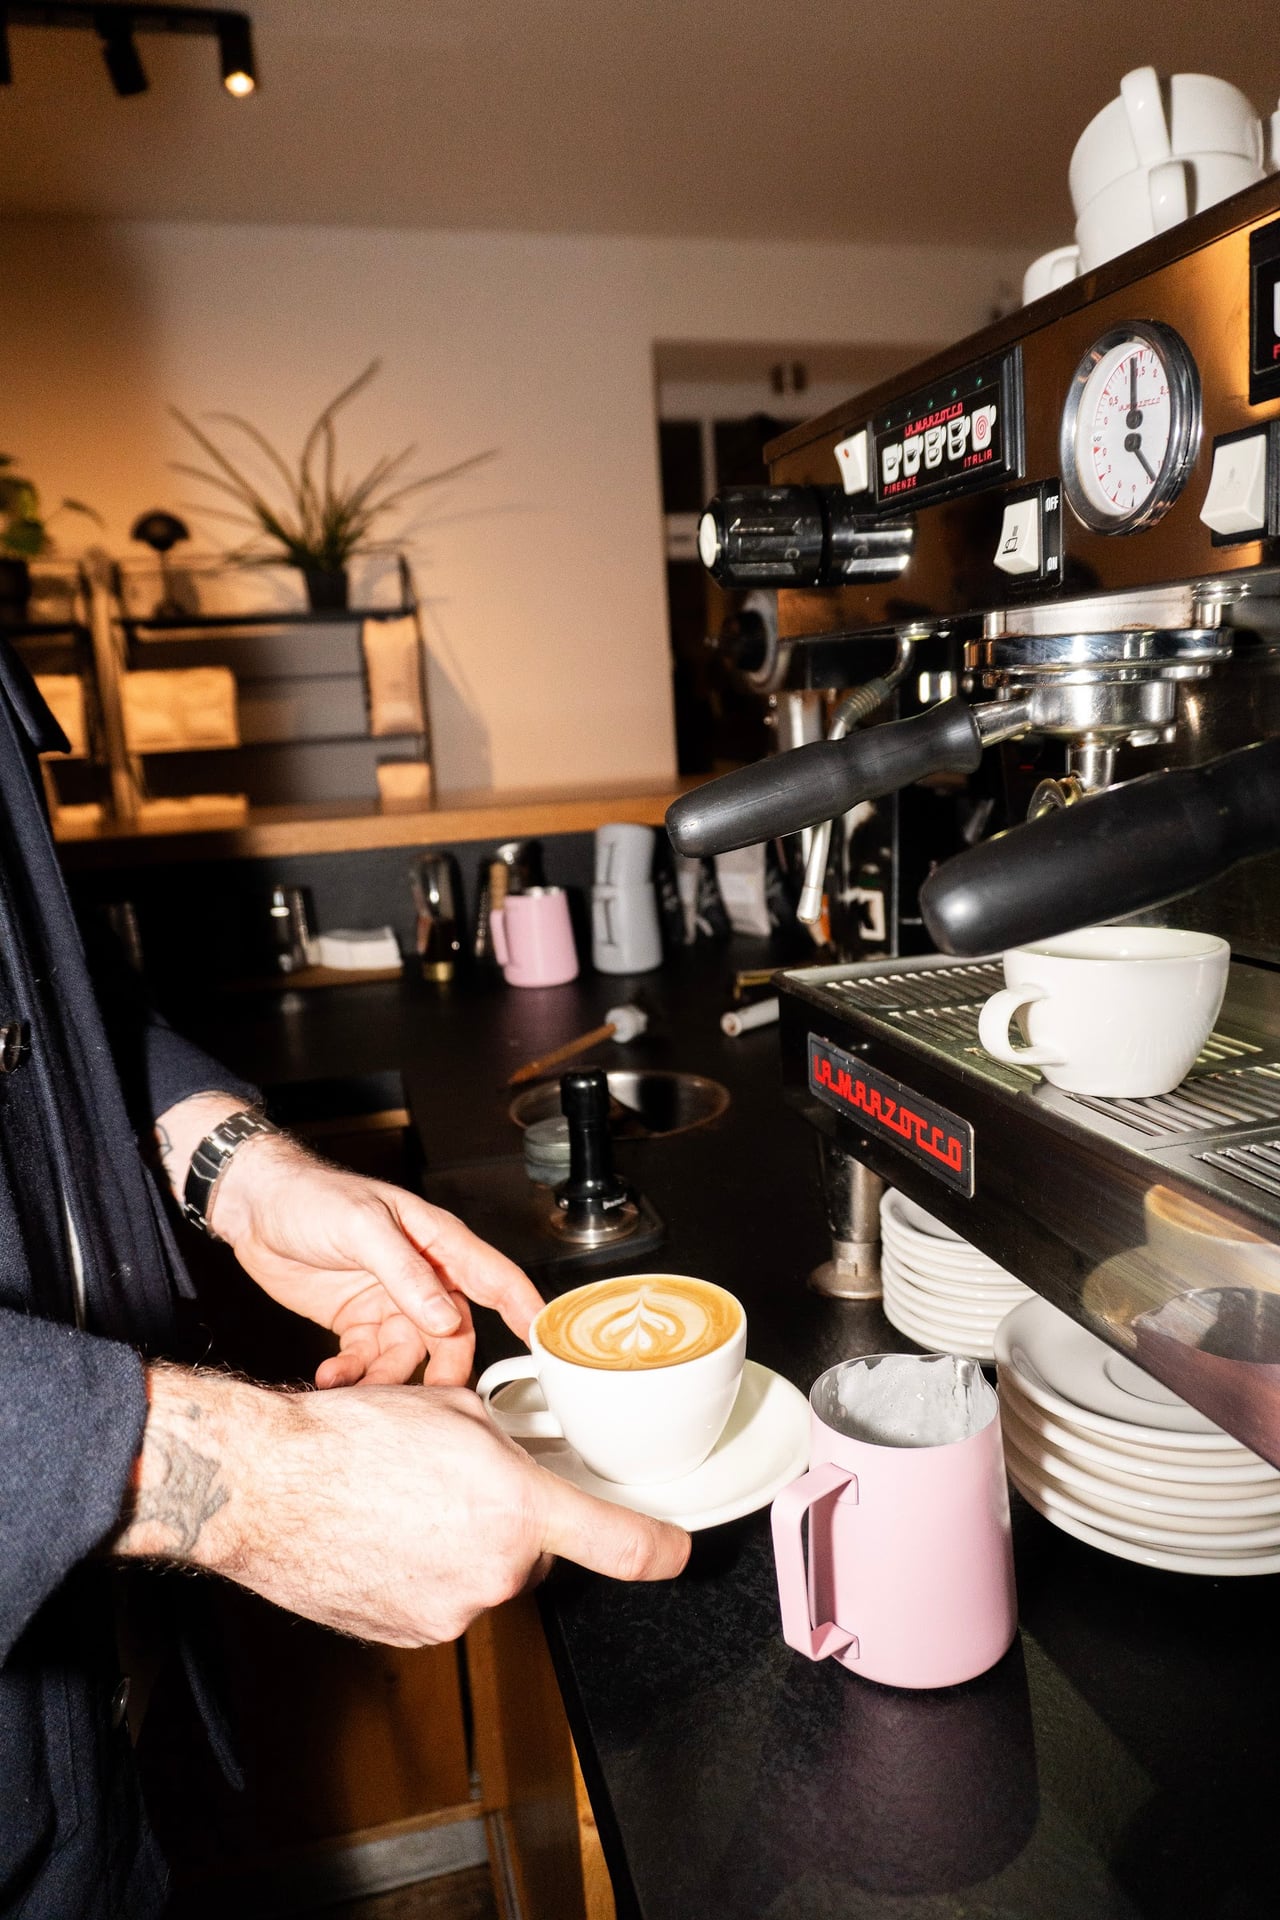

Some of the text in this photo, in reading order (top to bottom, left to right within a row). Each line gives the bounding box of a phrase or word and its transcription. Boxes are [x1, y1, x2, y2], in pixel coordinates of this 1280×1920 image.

[963, 448, 992, 468] ITALIA
[884, 476, 917, 496] FIRENZE
[1045, 495, 1058, 512] OFF
[1047, 556, 1058, 572] ON
